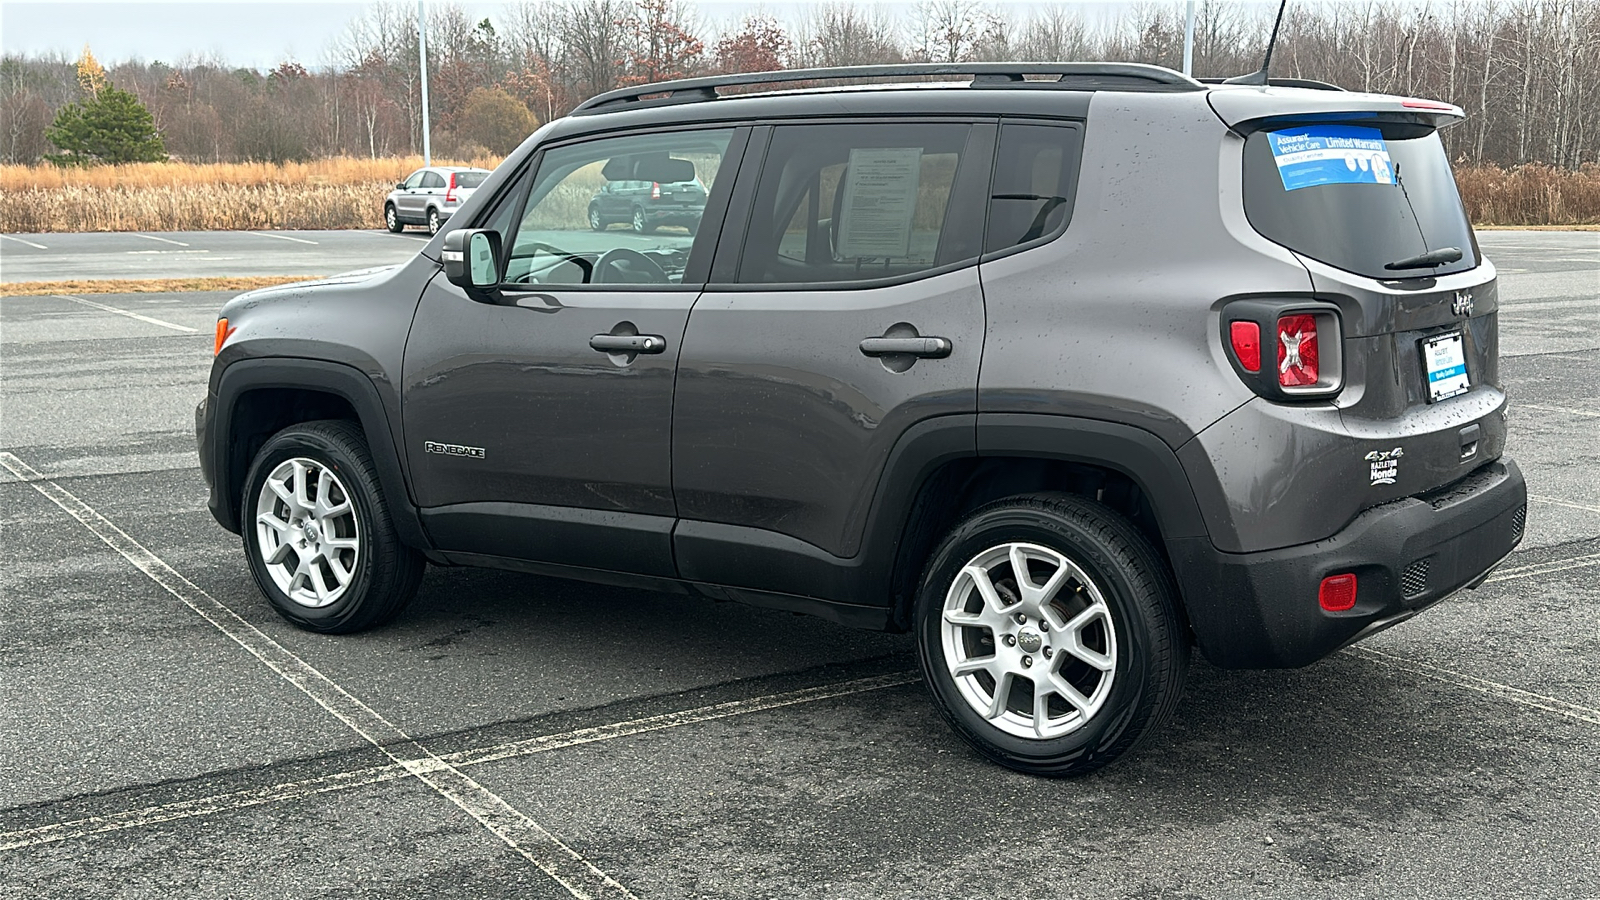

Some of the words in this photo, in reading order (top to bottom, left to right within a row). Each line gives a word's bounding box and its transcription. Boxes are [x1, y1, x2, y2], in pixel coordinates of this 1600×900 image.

[1277, 133, 1309, 146] Assurant
[1325, 137, 1354, 149] Limited
[1354, 138, 1382, 151] Warranty
[1278, 142, 1305, 154] Vehicle
[1305, 141, 1320, 150] Care
[1451, 290, 1474, 316] Jeep
[424, 441, 486, 459] RENEGADE
[1370, 466, 1397, 480] Honda
